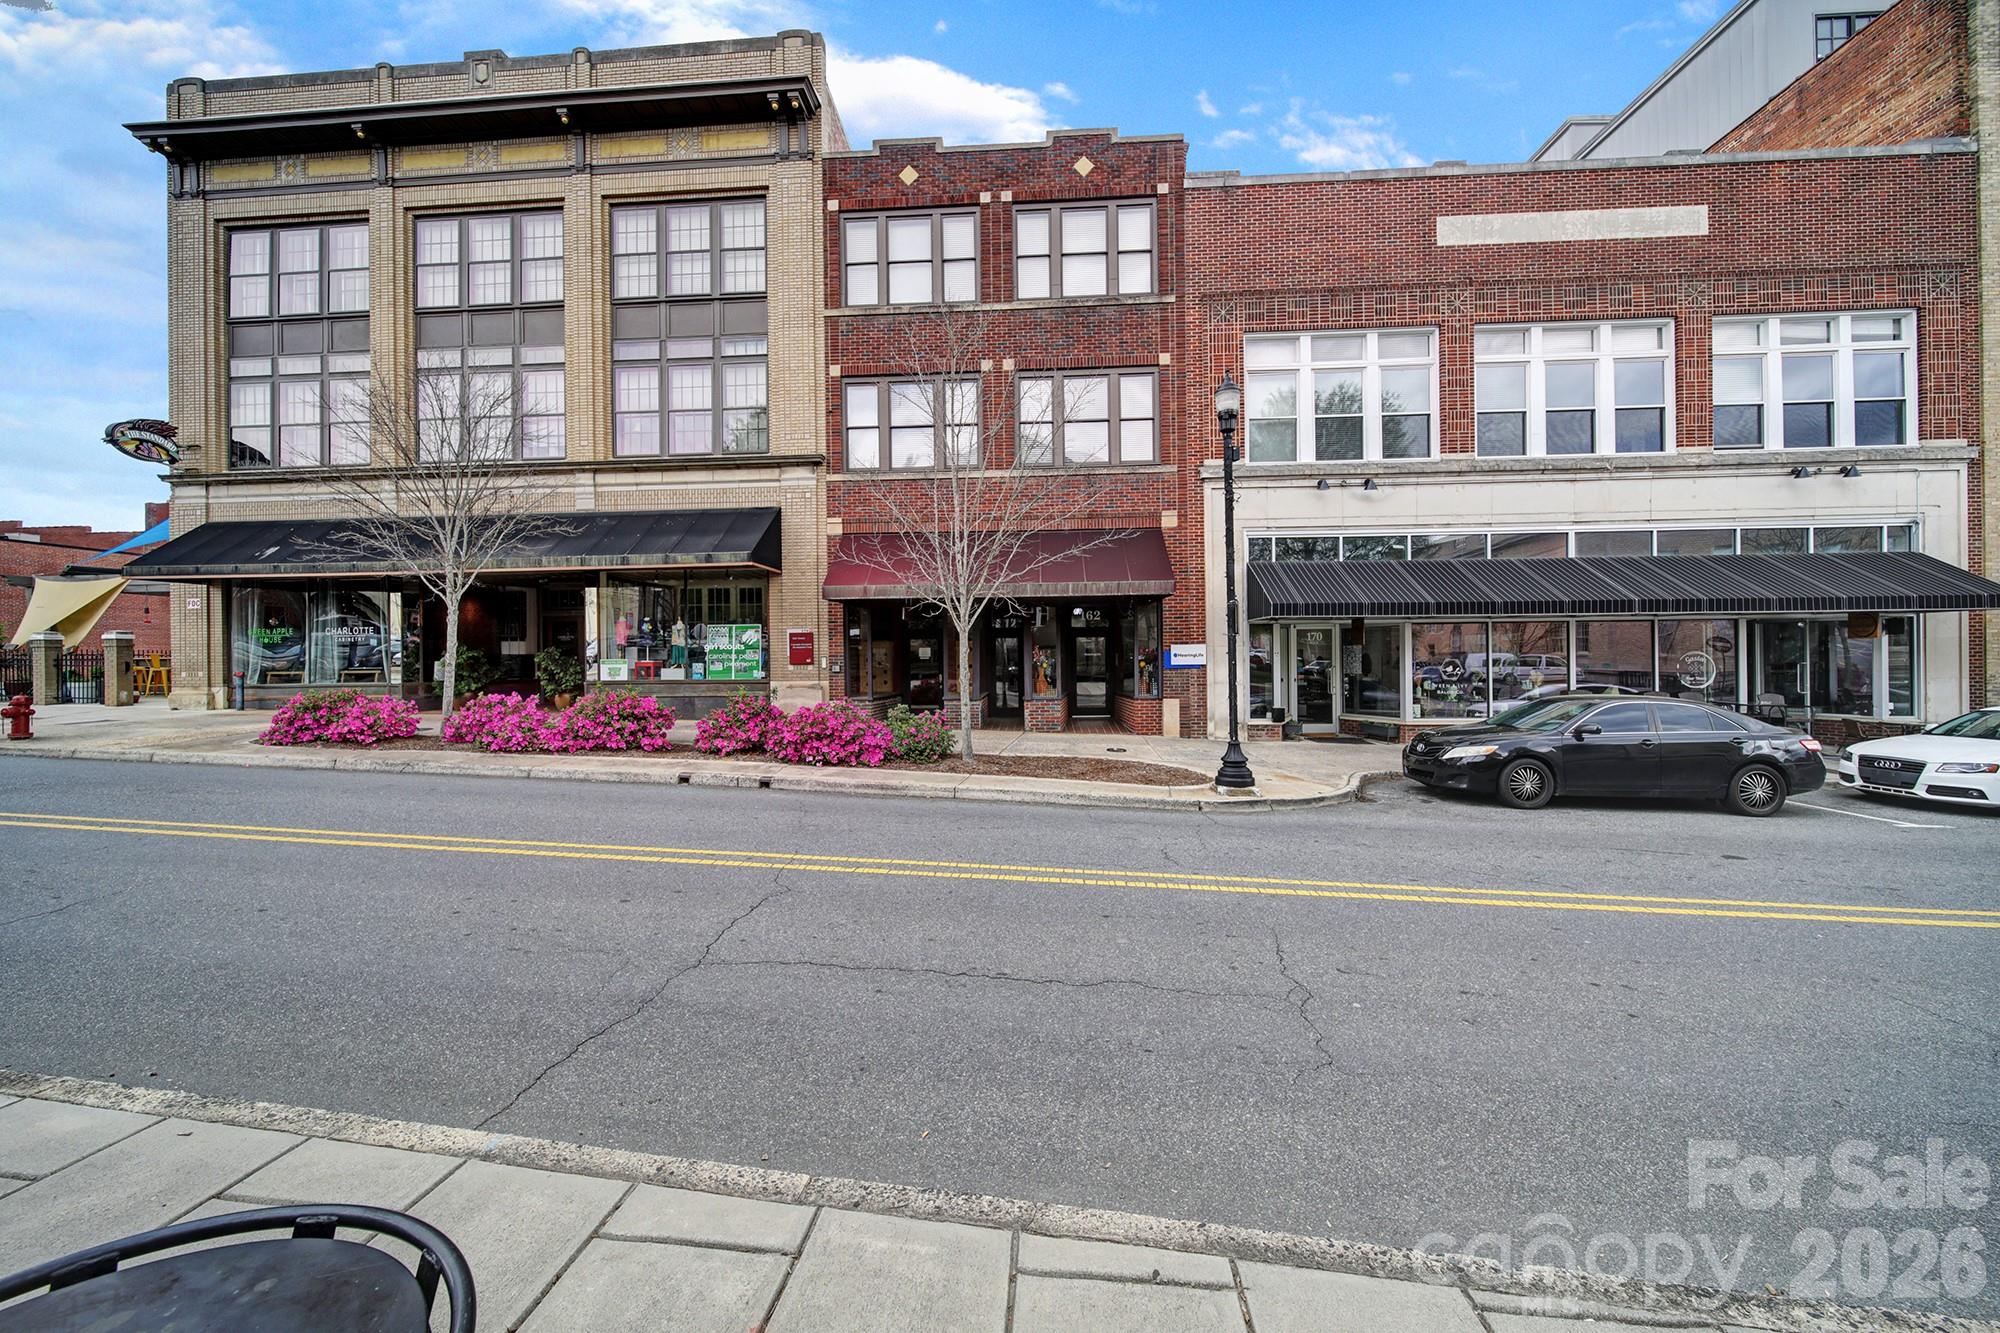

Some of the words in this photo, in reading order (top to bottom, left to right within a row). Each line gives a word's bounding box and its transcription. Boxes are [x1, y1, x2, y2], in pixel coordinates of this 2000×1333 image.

[127, 430, 140, 438] THE
[142, 431, 177, 452] STANDARD
[325, 626, 375, 636] CHARLOTTE
[1307, 632, 1323, 641] 170
